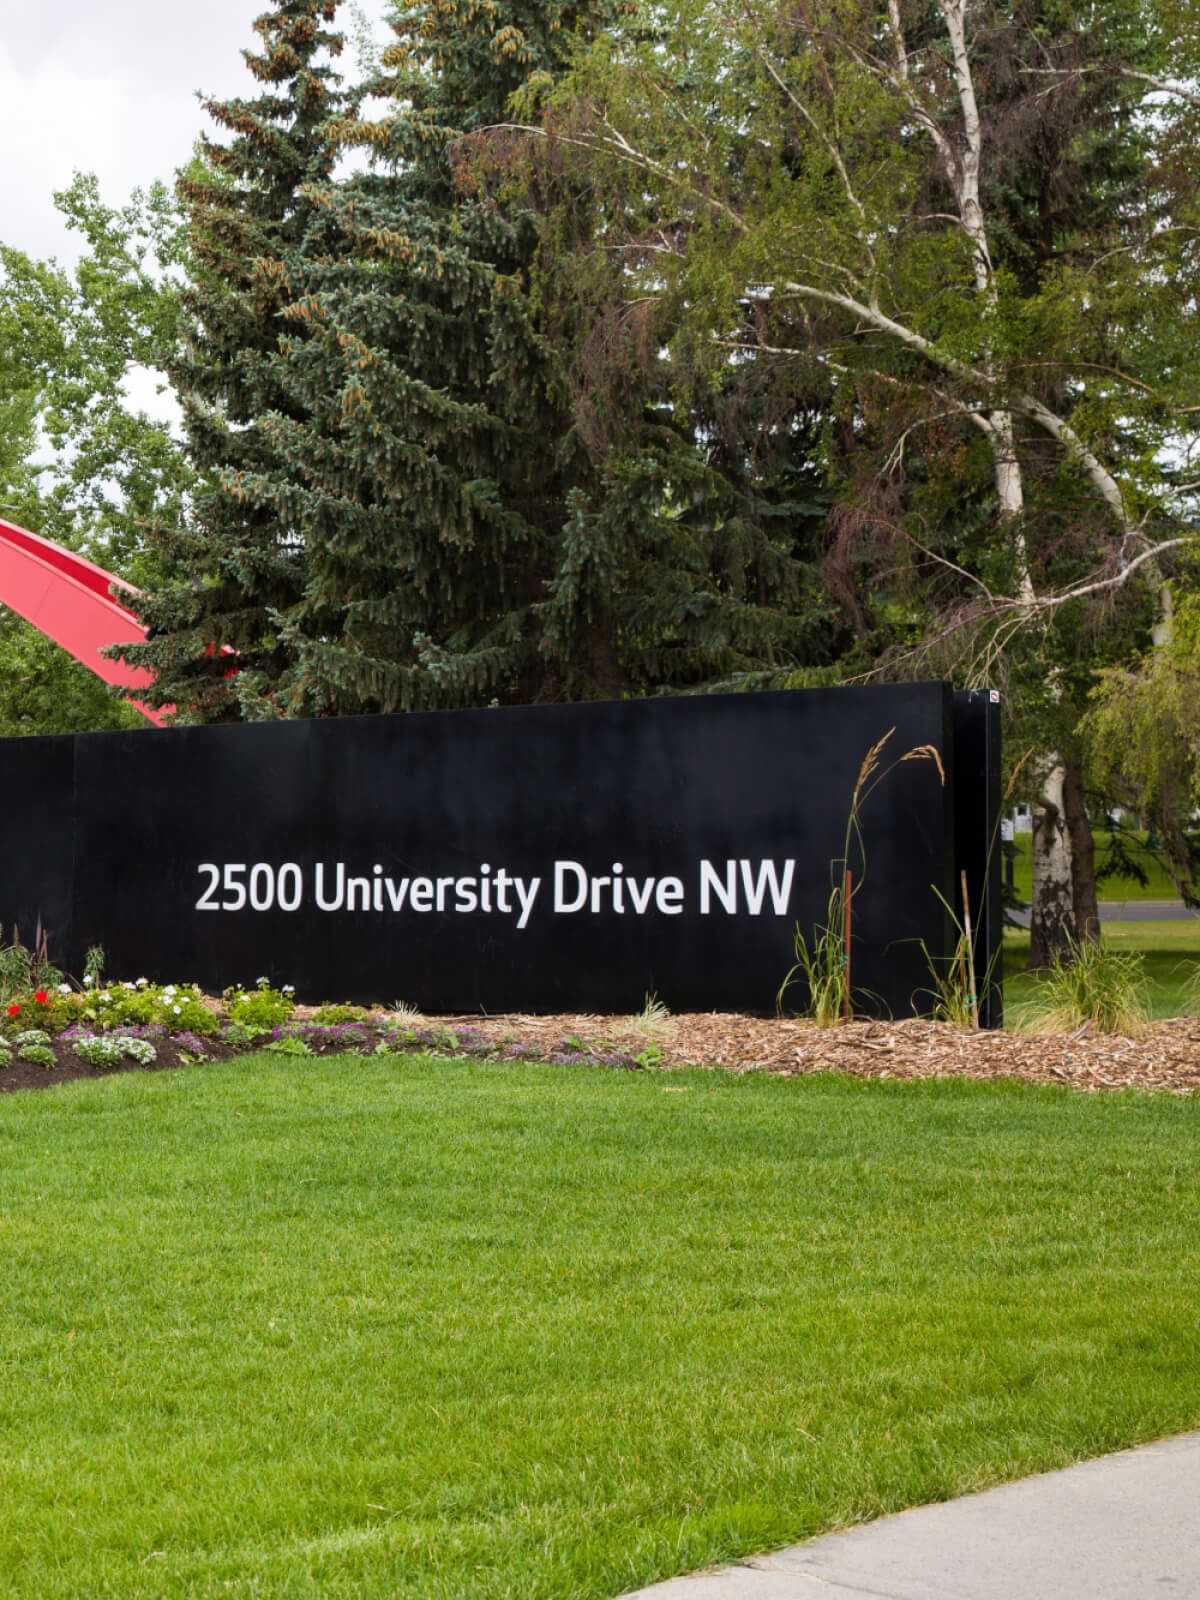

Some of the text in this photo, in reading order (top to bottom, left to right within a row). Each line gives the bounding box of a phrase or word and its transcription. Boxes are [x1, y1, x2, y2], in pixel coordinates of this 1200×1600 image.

[195, 858, 796, 929] 2500 University Drive NW
